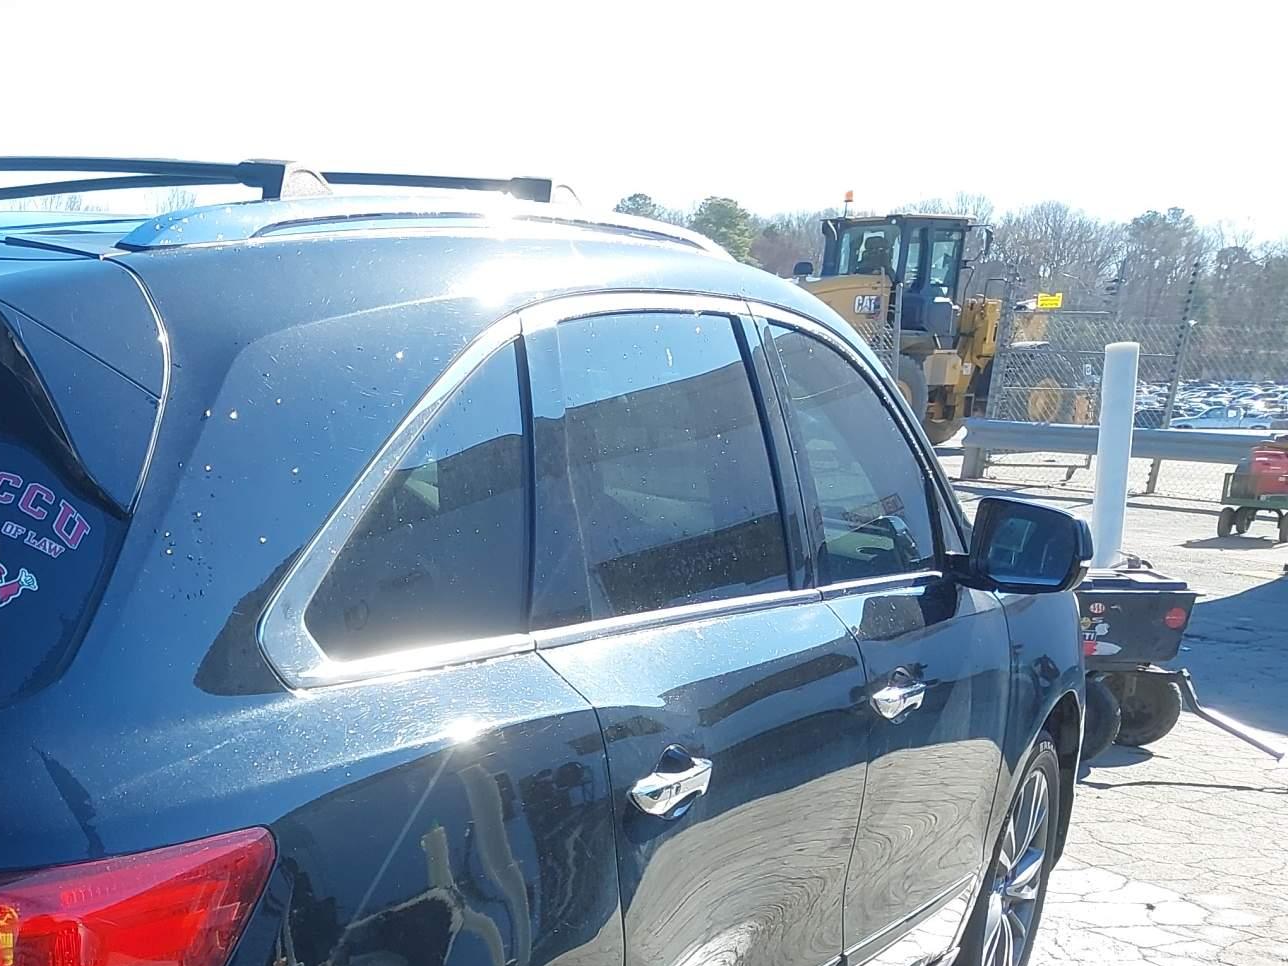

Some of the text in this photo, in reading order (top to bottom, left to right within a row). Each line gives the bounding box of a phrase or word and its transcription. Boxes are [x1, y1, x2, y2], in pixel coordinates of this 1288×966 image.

[854, 295, 878, 314] CAT
[1, 521, 26, 539] OF
[24, 531, 66, 559] LAW
